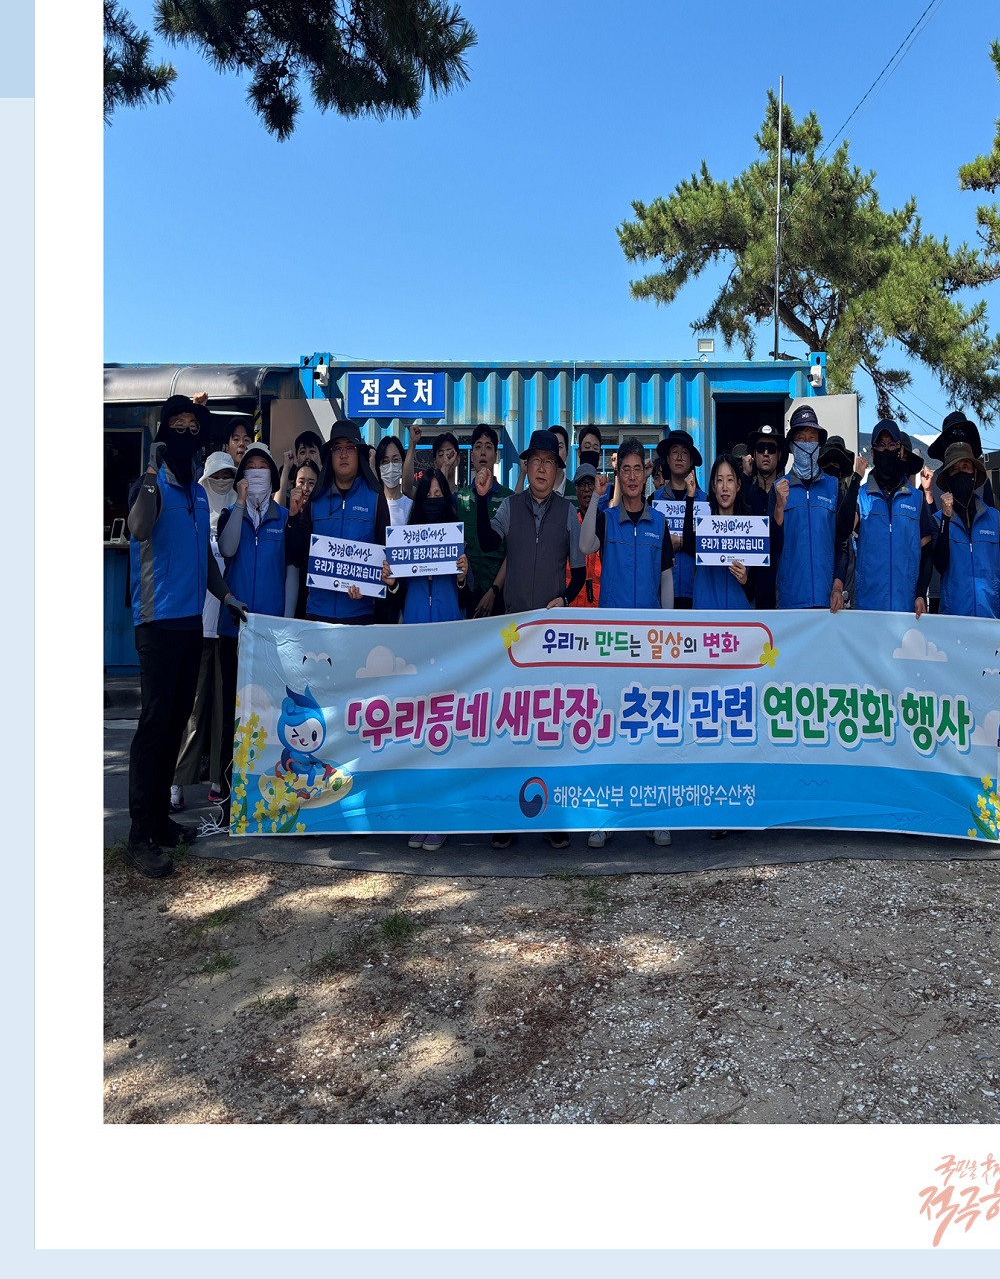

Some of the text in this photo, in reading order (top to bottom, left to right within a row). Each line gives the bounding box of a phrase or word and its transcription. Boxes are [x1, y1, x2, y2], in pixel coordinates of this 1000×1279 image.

[360, 379, 432, 406] 접수처
[391, 546, 459, 561] 우리가 앞장서겠습니다
[701, 539, 764, 551] 우리가 앞장서겠습니다
[314, 560, 382, 581] 우리가 앞장서겠습니다
[542, 629, 739, 659] 우리가 만드는 일상의 변화
[620, 686, 680, 739] 추진
[690, 686, 752, 738] 관련
[764, 686, 893, 743] 연안정화
[901, 692, 970, 750] 행사
[553, 784, 756, 808] 해양수산부 인천지방해양수산청
